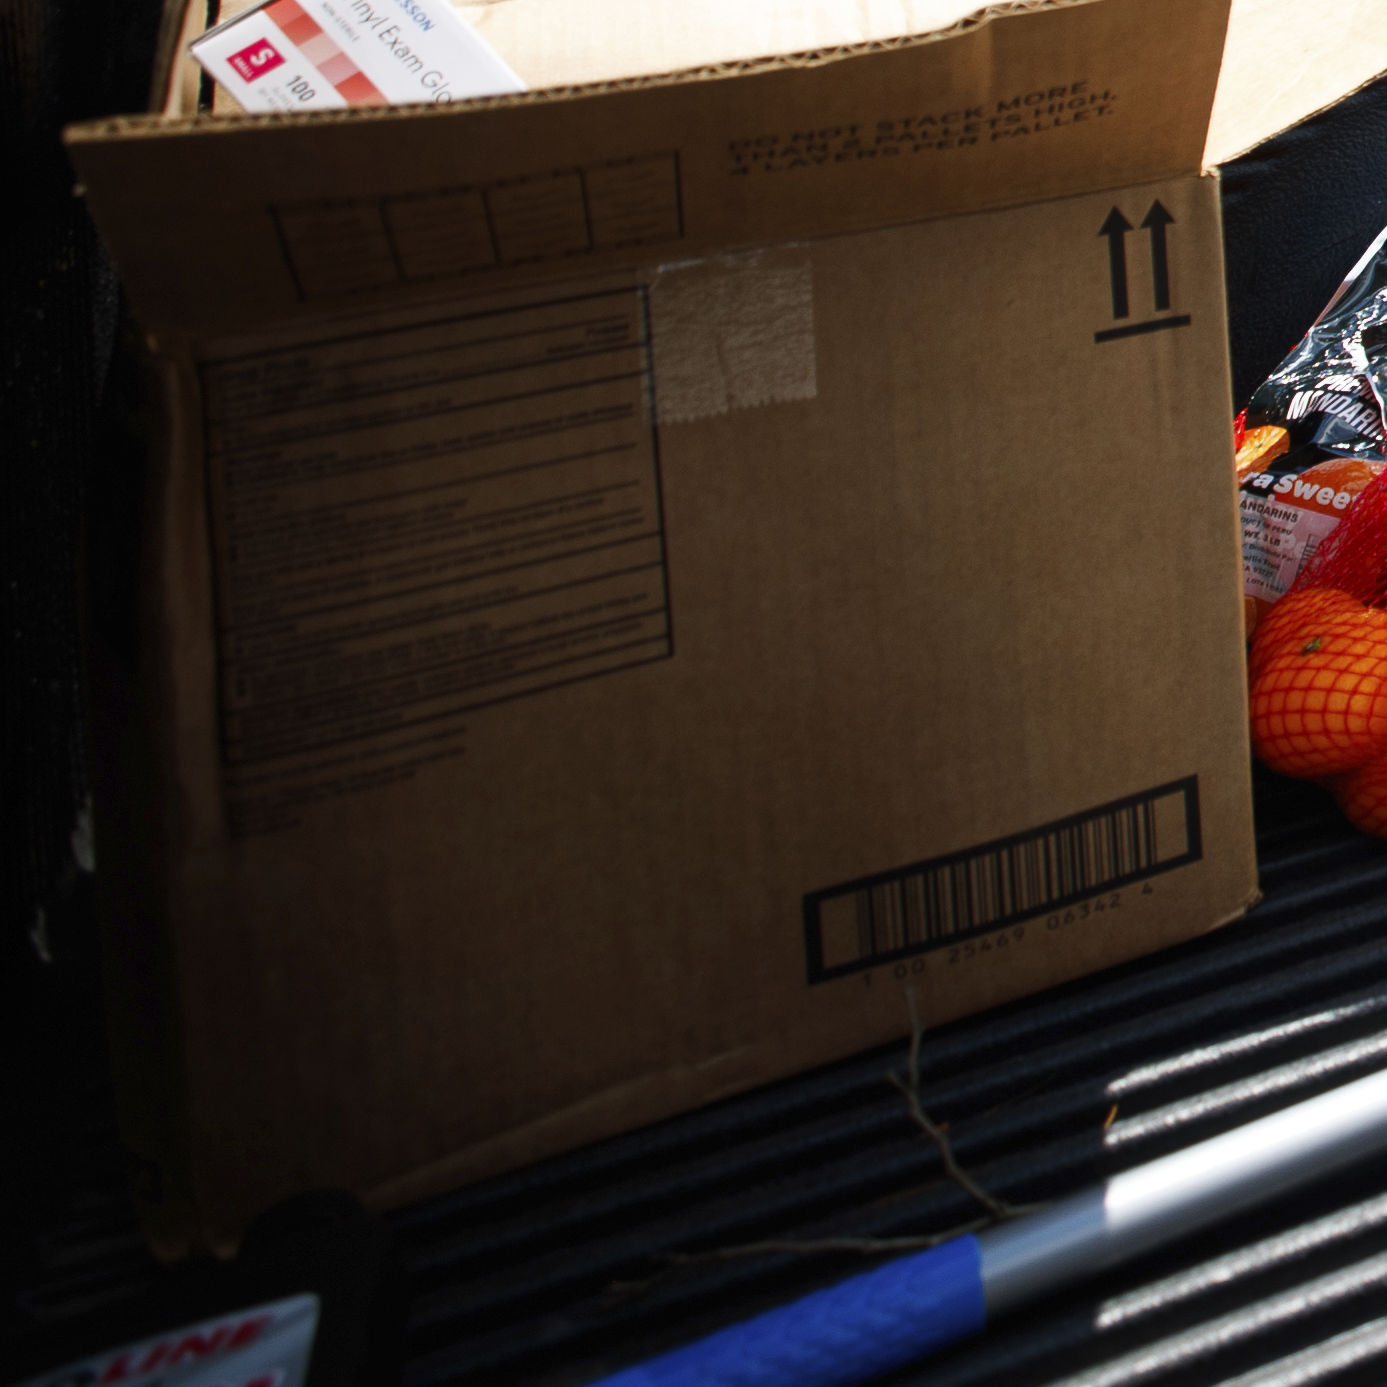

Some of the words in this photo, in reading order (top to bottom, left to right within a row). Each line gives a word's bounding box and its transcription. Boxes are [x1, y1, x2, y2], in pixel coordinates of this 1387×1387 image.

[249, 47, 275, 67] S
[378, 24, 423, 74] Exam
[286, 74, 317, 102] 100
[792, 123, 859, 141] NOT
[876, 105, 983, 132] STACK
[996, 80, 1088, 112] MORE
[874, 114, 1022, 145] PALLETS
[1033, 89, 1117, 119] HIGH.
[912, 136, 978, 154] PER
[1239, 472, 1274, 489] ra
[1240, 500, 1299, 523] ANDARINS
[892, 959, 928, 980] 00
[949, 925, 1026, 963] 25469
[1046, 893, 1122, 931] 06342
